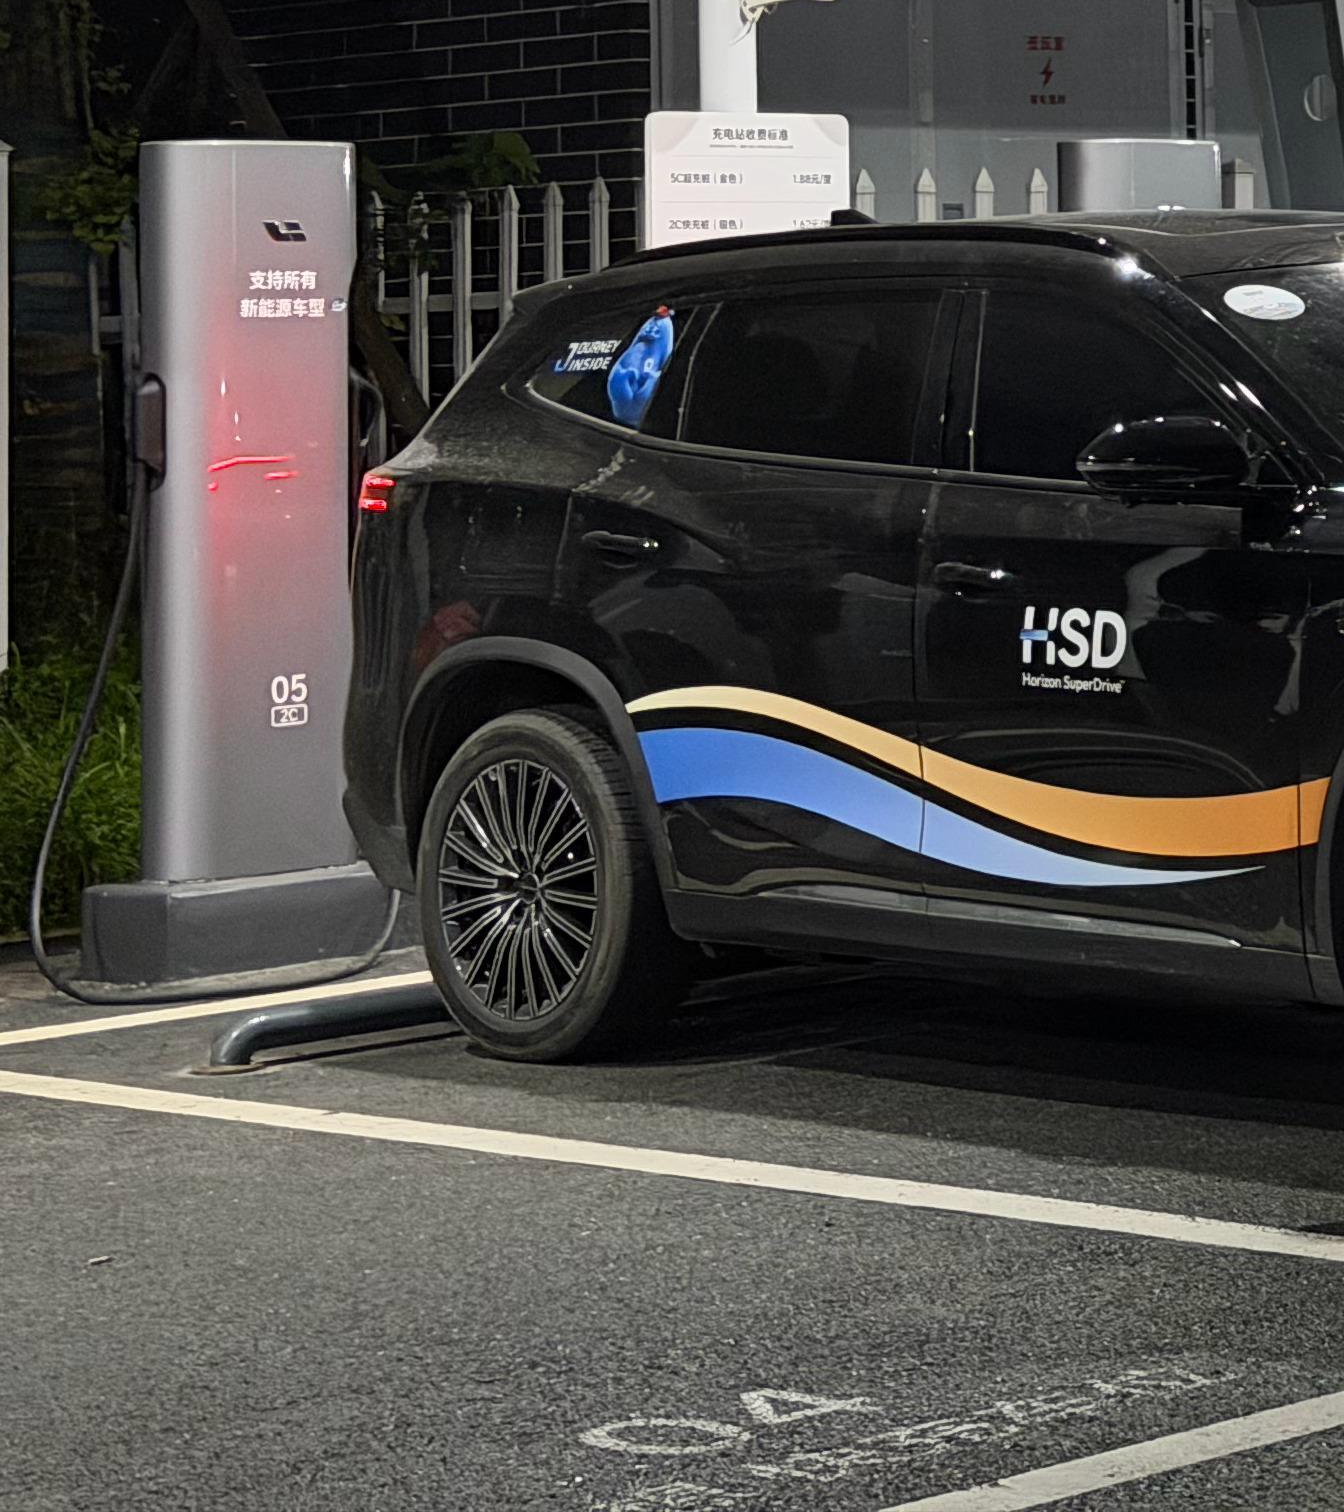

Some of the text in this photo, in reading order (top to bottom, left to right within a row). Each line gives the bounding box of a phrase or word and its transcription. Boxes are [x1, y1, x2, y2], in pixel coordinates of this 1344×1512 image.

[712, 128, 789, 141] 充电站收费标准
[248, 270, 317, 291] 支持所有
[240, 298, 325, 318] 新能源车型
[554, 339, 622, 372] JOURNEY
[566, 356, 613, 372] INSIDE
[1019, 605, 1127, 669] HSD
[271, 673, 308, 704] 05
[1021, 671, 1062, 689] Horizon
[279, 708, 299, 723] 2C
[577, 1387, 886, 1456] 04
